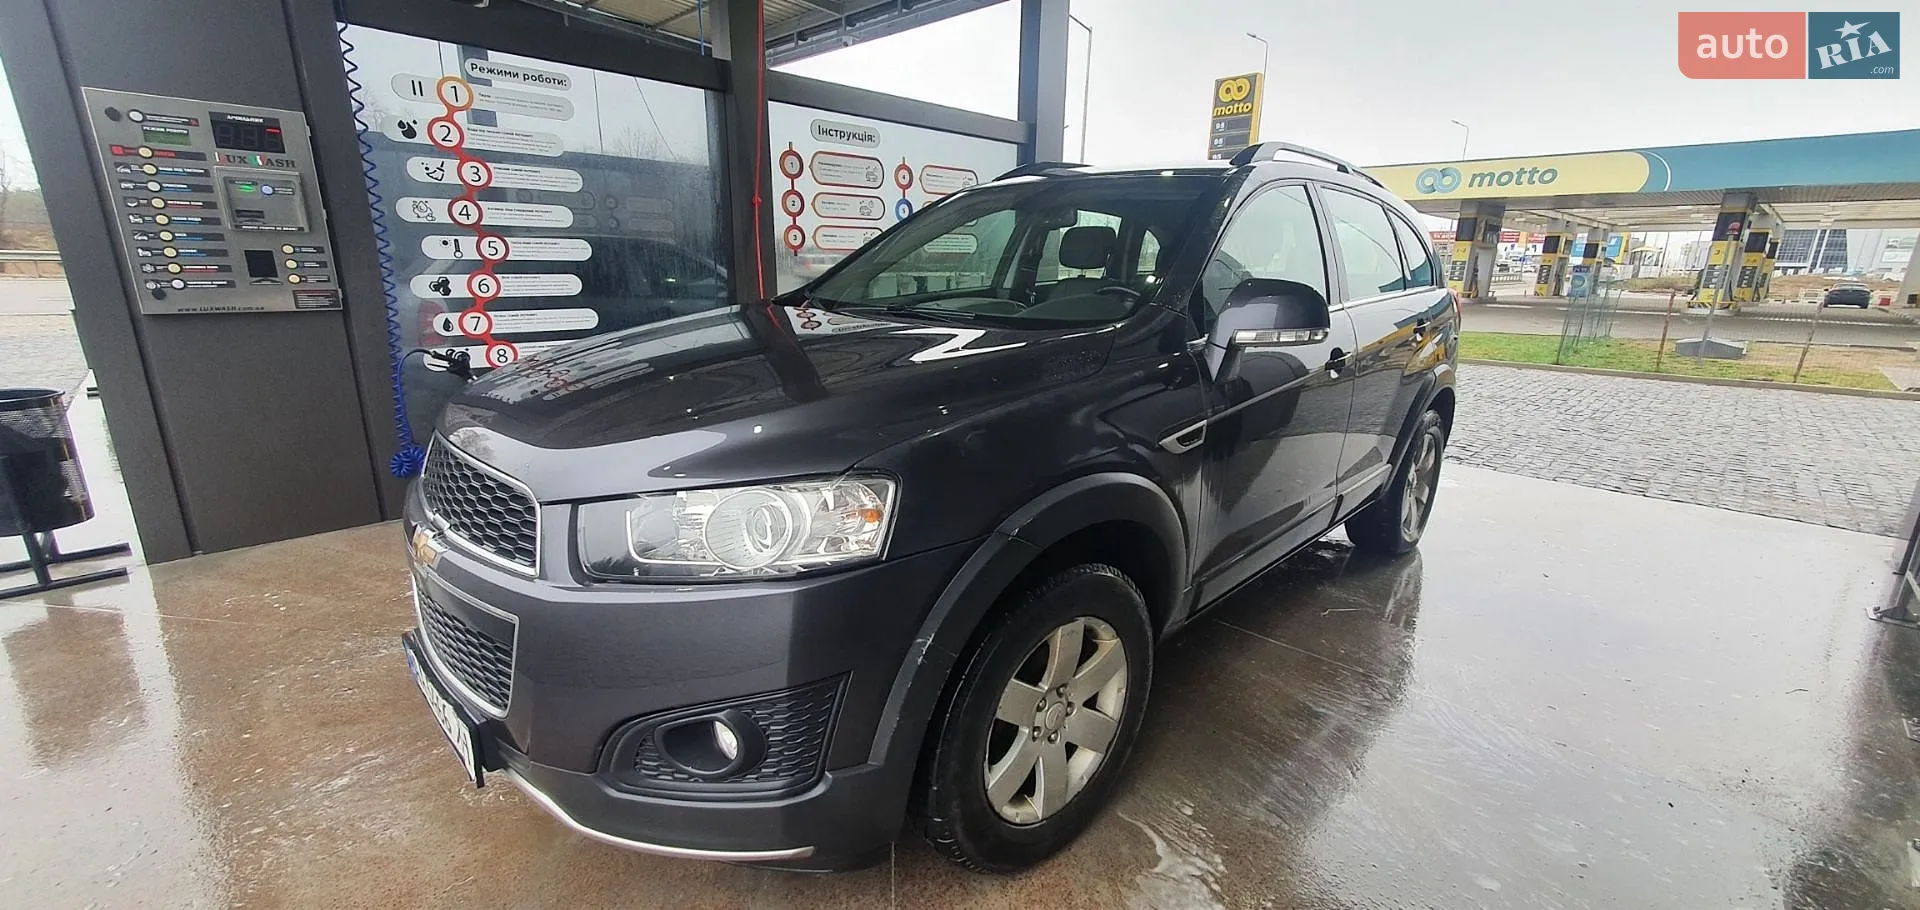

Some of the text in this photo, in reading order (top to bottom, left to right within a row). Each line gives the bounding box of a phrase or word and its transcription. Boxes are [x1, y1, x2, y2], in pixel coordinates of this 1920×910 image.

[470, 62, 567, 87] Режими роботи:
[450, 85, 459, 102] 1
[1213, 102, 1253, 116] motto
[439, 124, 453, 142] 2
[818, 124, 876, 143] Інструкція:
[470, 165, 482, 182] 3
[1468, 166, 1558, 188] motto
[458, 204, 472, 220] 4
[488, 240, 498, 256] 5
[478, 278, 490, 293] 6
[470, 316, 480, 331] 7
[497, 348, 508, 363] 8
